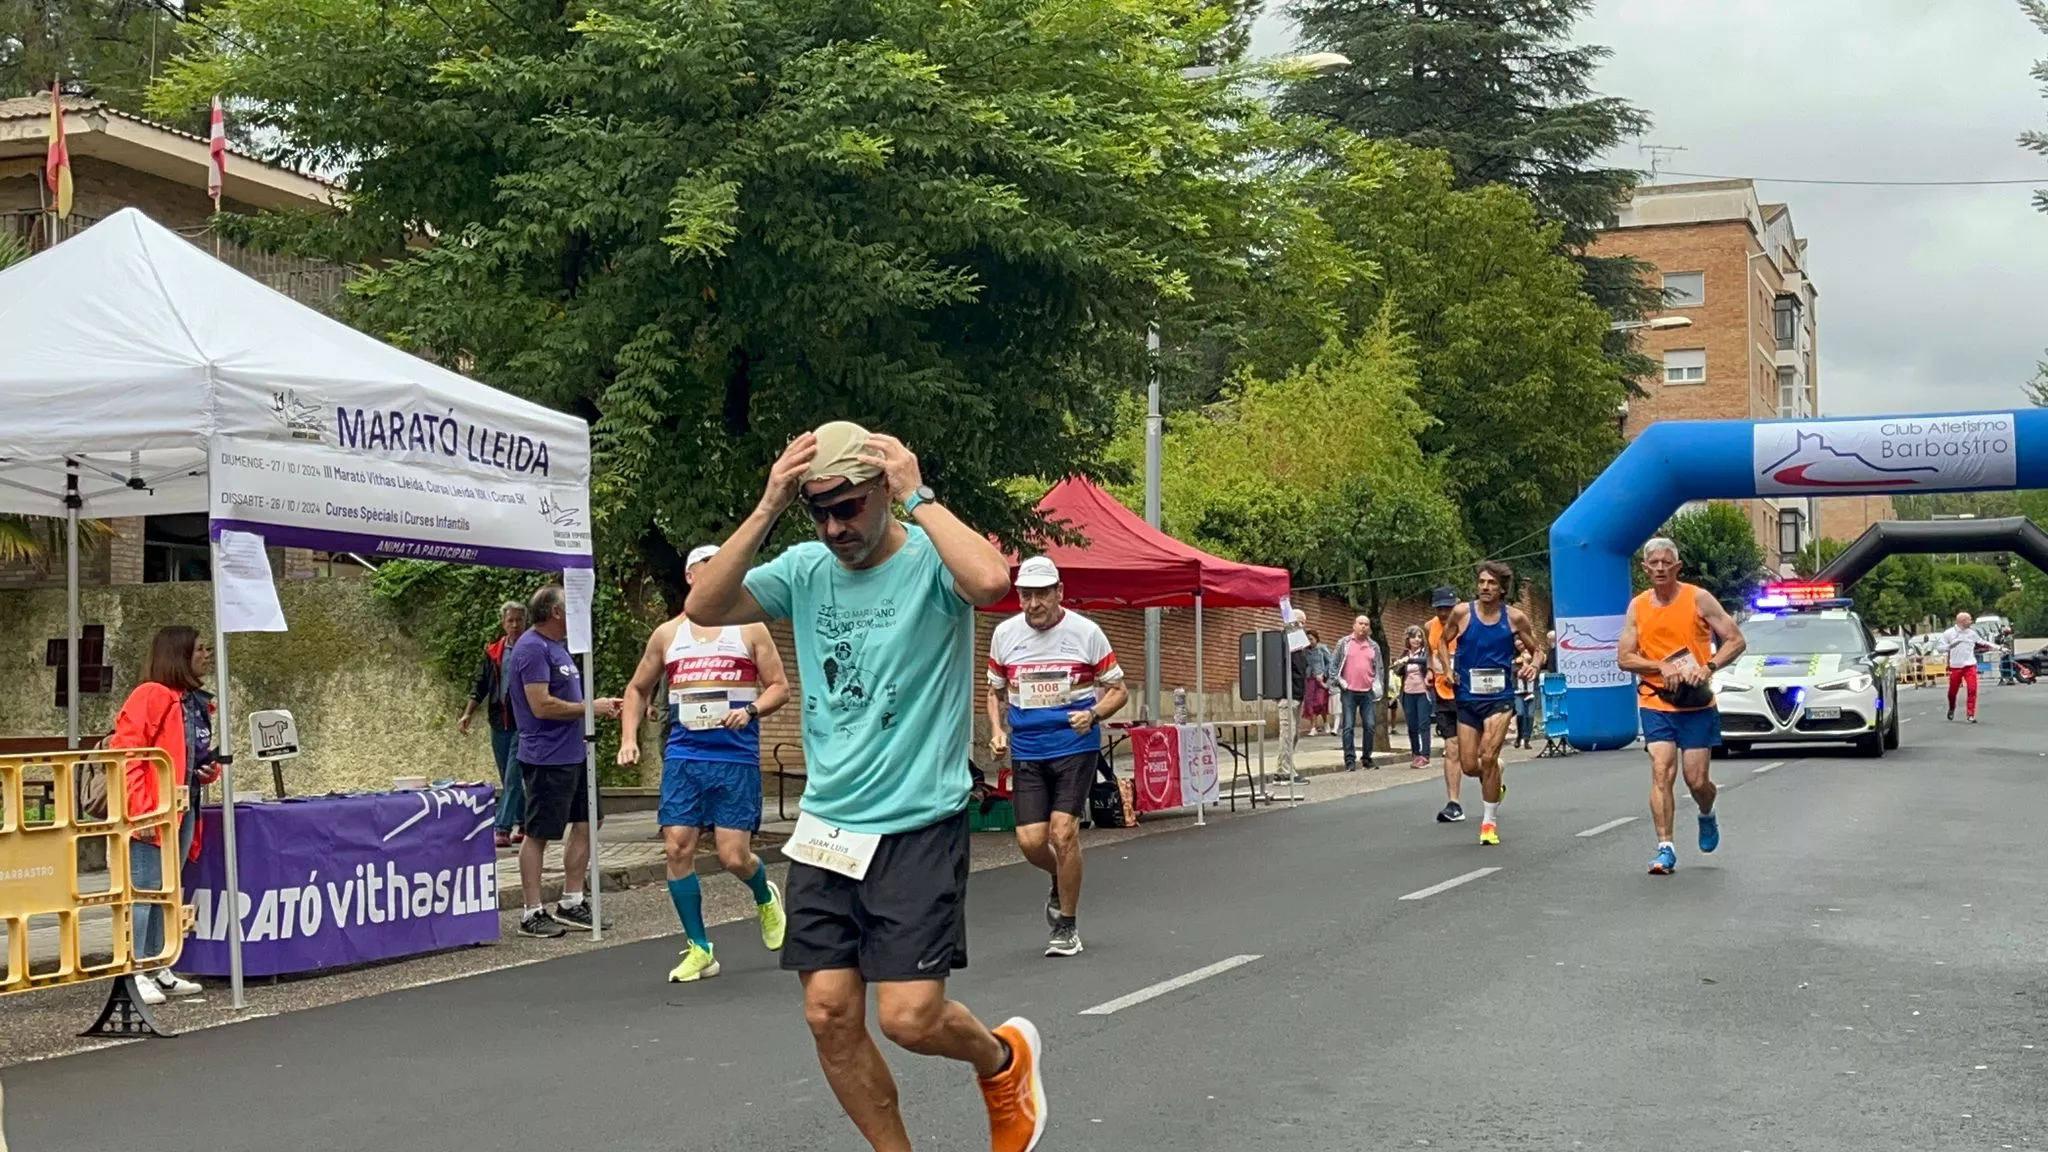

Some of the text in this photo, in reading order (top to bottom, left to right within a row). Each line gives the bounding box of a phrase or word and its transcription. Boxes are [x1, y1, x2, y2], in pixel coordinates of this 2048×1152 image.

[1880, 420, 2007, 436] Club Atletismo
[337, 406, 549, 477] MARATÓ LLEIDA
[1881, 436, 2008, 459] Barbastro
[221, 453, 265, 470] DIUMENGE
[334, 467, 366, 483] Marató
[367, 471, 396, 488] Vithas
[221, 492, 264, 508] DISSABTE
[325, 501, 358, 519] Curses
[405, 512, 435, 527] Curses
[436, 515, 470, 531] Infantils
[1567, 671, 1626, 684] arbastro
[1031, 683, 1059, 693] 1008
[700, 704, 708, 713] 6
[808, 838, 849, 854] JUAN LUIS
[182, 870, 322, 942] ARATÓ
[326, 860, 451, 928] vithas
